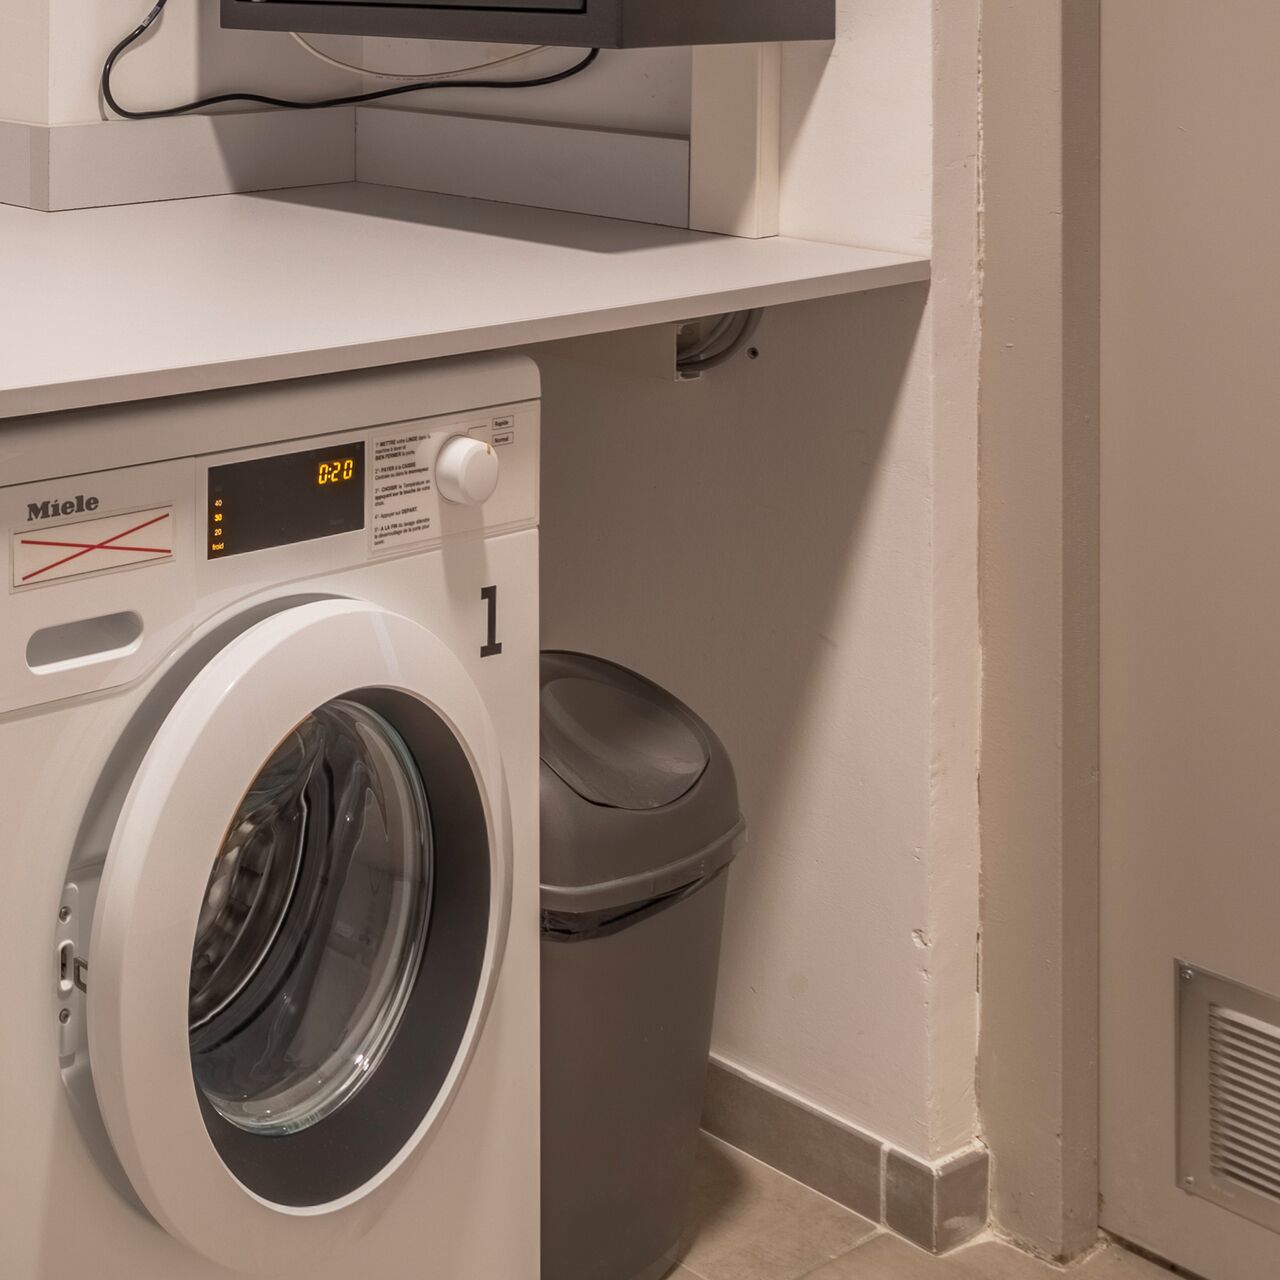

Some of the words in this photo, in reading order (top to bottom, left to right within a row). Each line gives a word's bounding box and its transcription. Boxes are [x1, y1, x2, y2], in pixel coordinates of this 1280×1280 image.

[26, 493, 99, 522] Miele
[213, 499, 223, 507] 40
[213, 513, 223, 522] 30
[213, 528, 223, 537] 20
[212, 542, 224, 551] froid
[479, 585, 503, 658] 1
